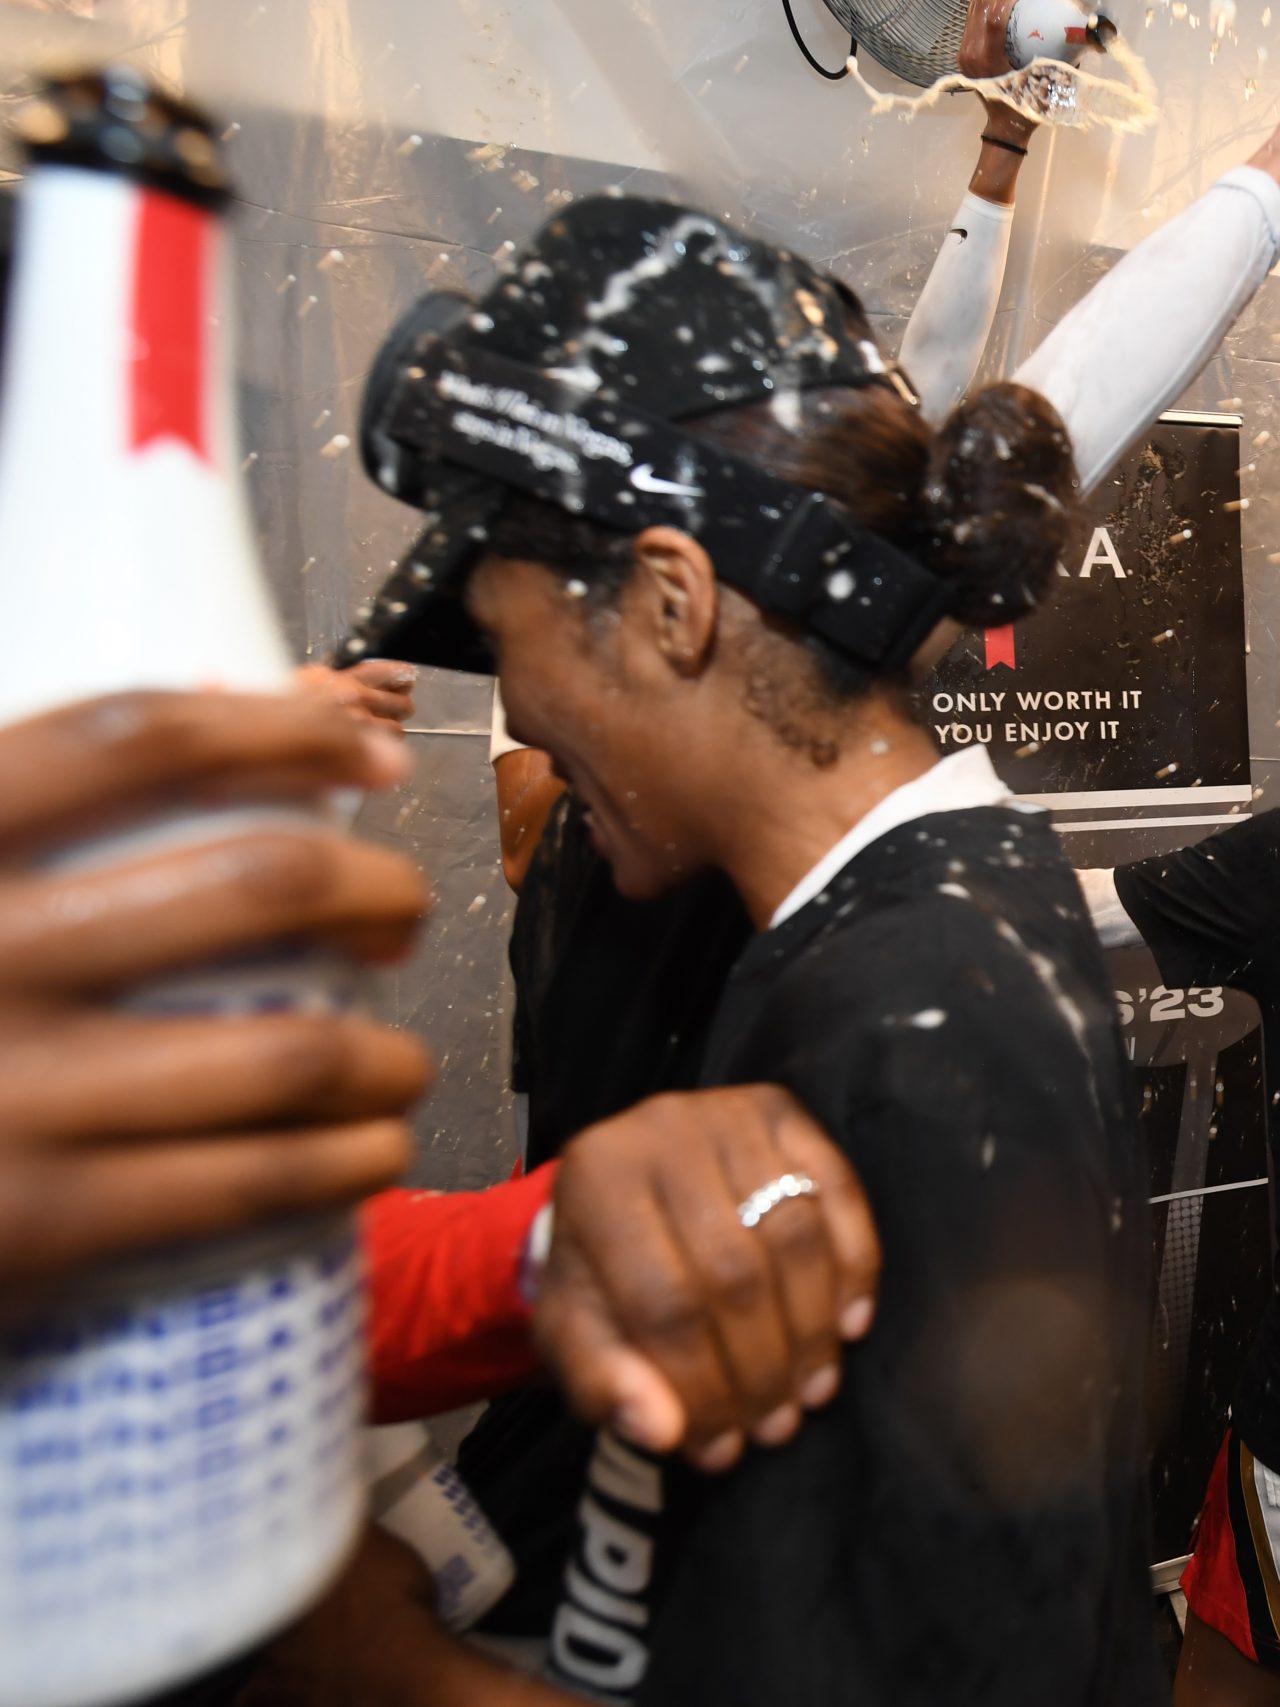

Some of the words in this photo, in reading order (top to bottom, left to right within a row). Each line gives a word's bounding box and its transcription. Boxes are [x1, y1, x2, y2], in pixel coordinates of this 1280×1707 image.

[932, 692, 1006, 713] ONLY
[1016, 690, 1111, 712] WORTH
[1122, 690, 1143, 710] IT
[934, 724, 993, 744] YOU
[1005, 721, 1090, 743] ENJOY
[1100, 720, 1120, 740] IT
